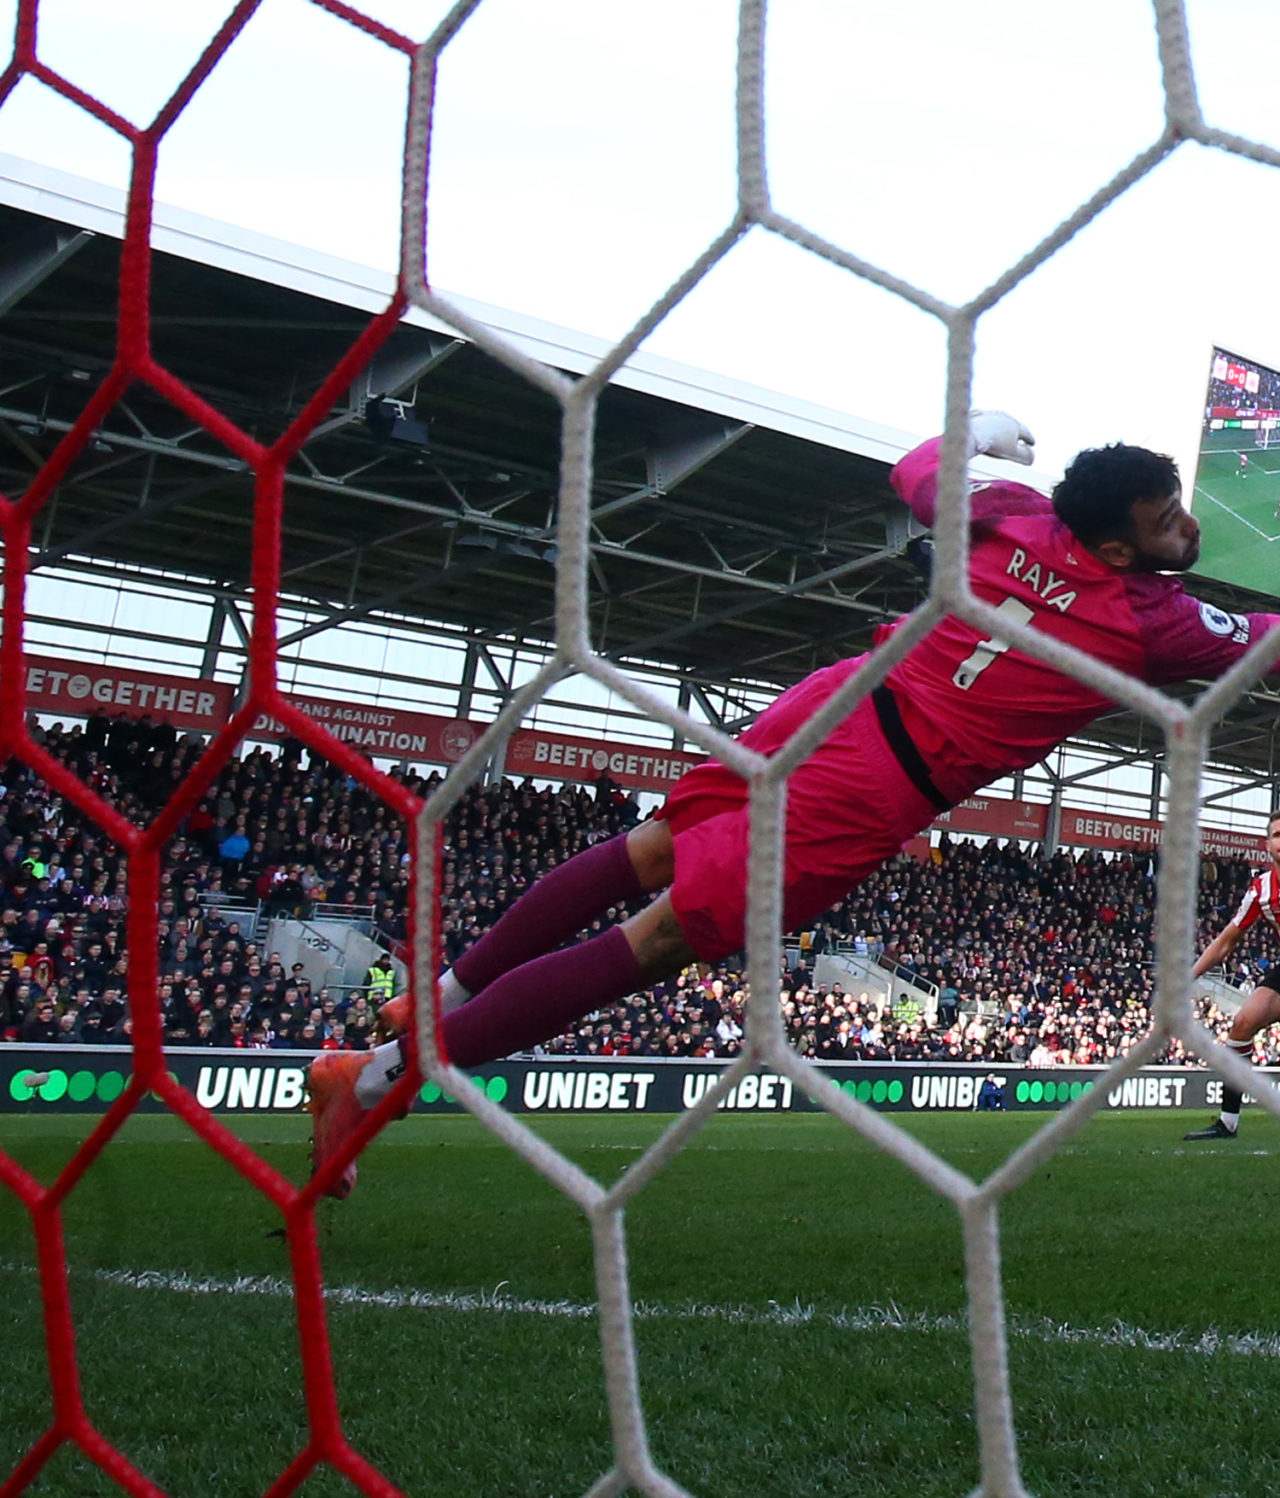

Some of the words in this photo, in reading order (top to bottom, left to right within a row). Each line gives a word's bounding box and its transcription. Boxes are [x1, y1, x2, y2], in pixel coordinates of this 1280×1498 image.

[1007, 549, 1078, 613] RAYA
[26, 667, 217, 716] ETOGETHER
[332, 708, 396, 727] AGAINST
[197, 1066, 306, 1108] UNIB
[522, 1071, 655, 1109] UNIBET
[1205, 1081, 1224, 1104] SE
